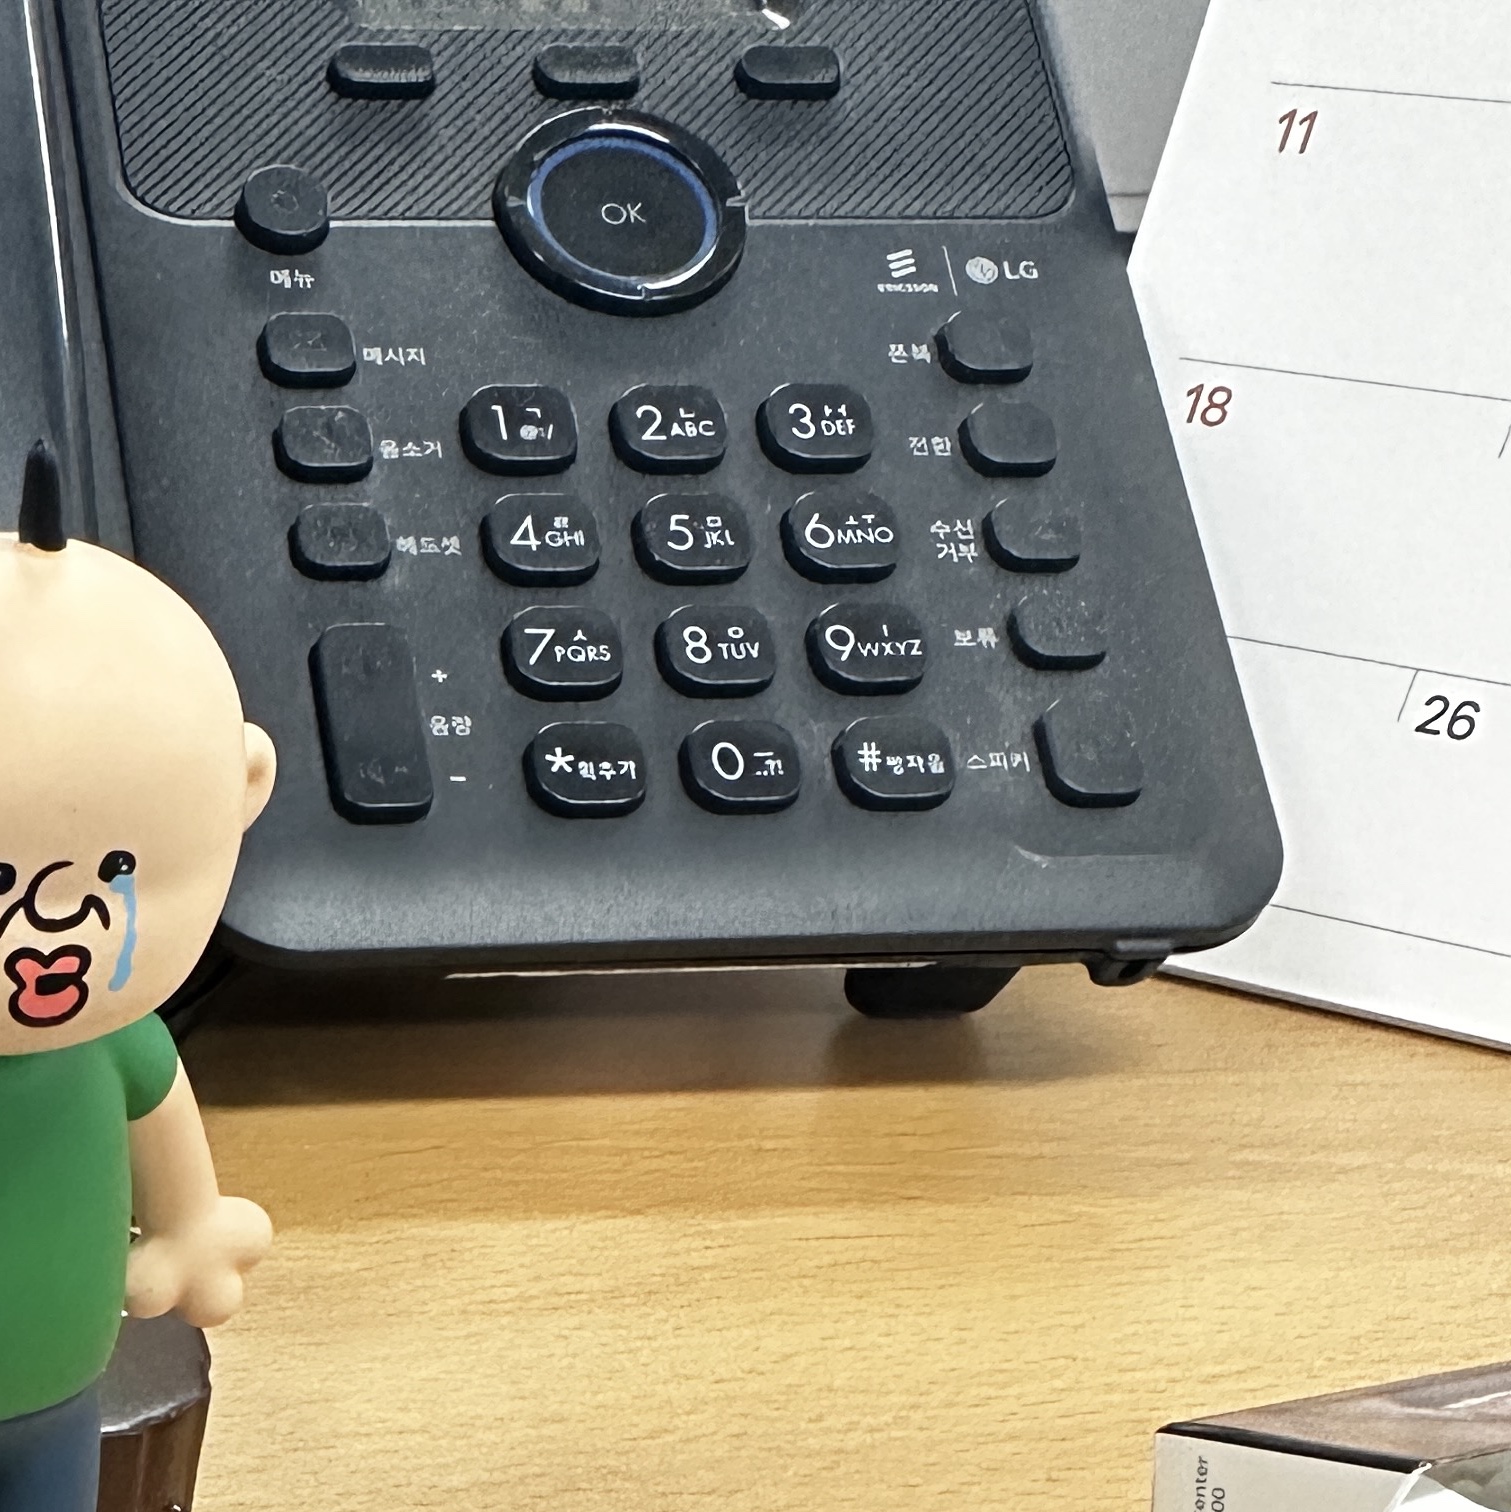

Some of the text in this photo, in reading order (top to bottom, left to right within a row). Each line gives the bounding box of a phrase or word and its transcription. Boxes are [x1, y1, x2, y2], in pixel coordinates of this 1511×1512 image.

[1278, 108, 1319, 155] 11
[601, 202, 646, 225] OK
[269, 269, 315, 289] 메뉴
[1002, 260, 1039, 280] LG
[362, 347, 426, 366] 메시지
[1186, 383, 1233, 428] 18
[490, 404, 508, 441] 1
[635, 404, 667, 441] 2
[670, 420, 716, 438] ABC
[788, 403, 816, 440] 3
[820, 419, 856, 436] DEF
[380, 439, 443, 460] 음소거
[509, 514, 542, 552] 4
[544, 529, 585, 547] GHI
[667, 514, 694, 551] 5
[704, 529, 735, 549] JKL
[804, 512, 835, 549] 6
[837, 526, 894, 545] MNO
[930, 519, 975, 540] 수신
[936, 542, 979, 564] 거부
[523, 627, 557, 666] 7
[554, 644, 611, 663] PQRS
[682, 625, 712, 664] 8
[717, 641, 760, 660] TUV
[824, 624, 856, 662] 9
[857, 639, 923, 657] WXYZ
[1414, 694, 1481, 741] 26
[711, 741, 745, 781] 0
